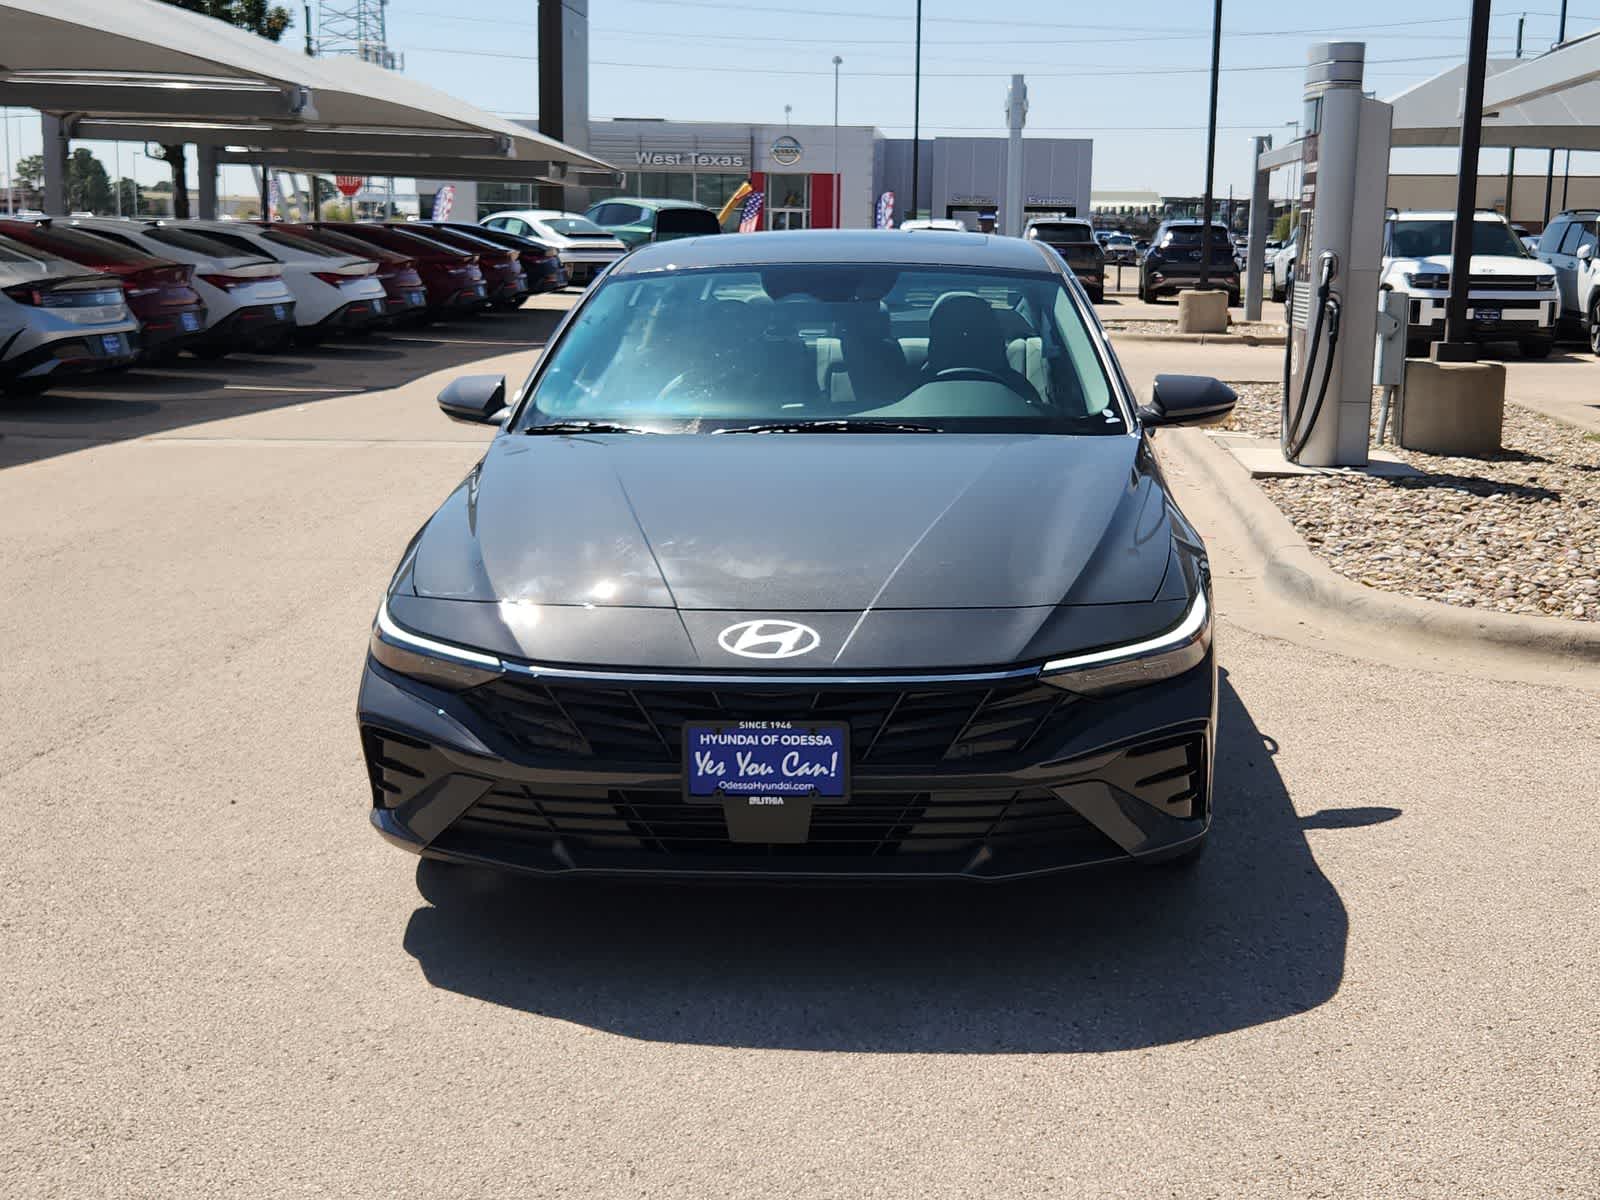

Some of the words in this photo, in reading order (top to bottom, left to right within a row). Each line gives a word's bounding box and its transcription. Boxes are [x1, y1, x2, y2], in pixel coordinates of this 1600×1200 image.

[636, 152, 681, 165] West
[689, 153, 744, 166] Texas
[739, 721, 767, 729] SINCE
[770, 721, 792, 729] 1946
[700, 734, 758, 745] HYUNDAI
[761, 735, 779, 746] OF
[781, 735, 832, 746] ODESSA
[695, 751, 726, 776] Yes
[736, 751, 774, 776] You
[782, 751, 838, 777] Can!
[718, 780, 815, 792] OdessaHyundai.com
